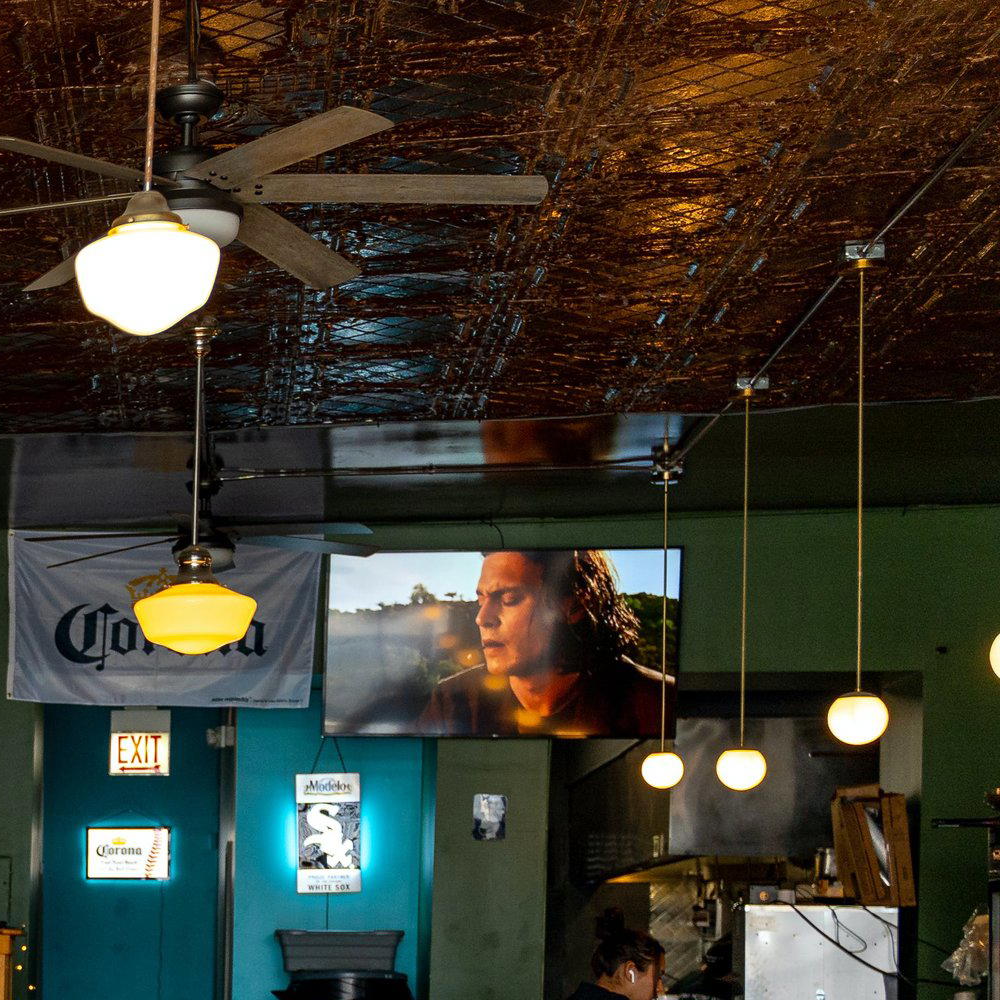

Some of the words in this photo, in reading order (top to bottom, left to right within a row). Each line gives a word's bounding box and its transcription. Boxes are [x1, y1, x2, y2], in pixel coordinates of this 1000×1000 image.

[55, 603, 267, 671] Coa
[118, 735, 162, 763] EXIT
[308, 780, 347, 792] Modelo
[96, 844, 143, 858] Corona
